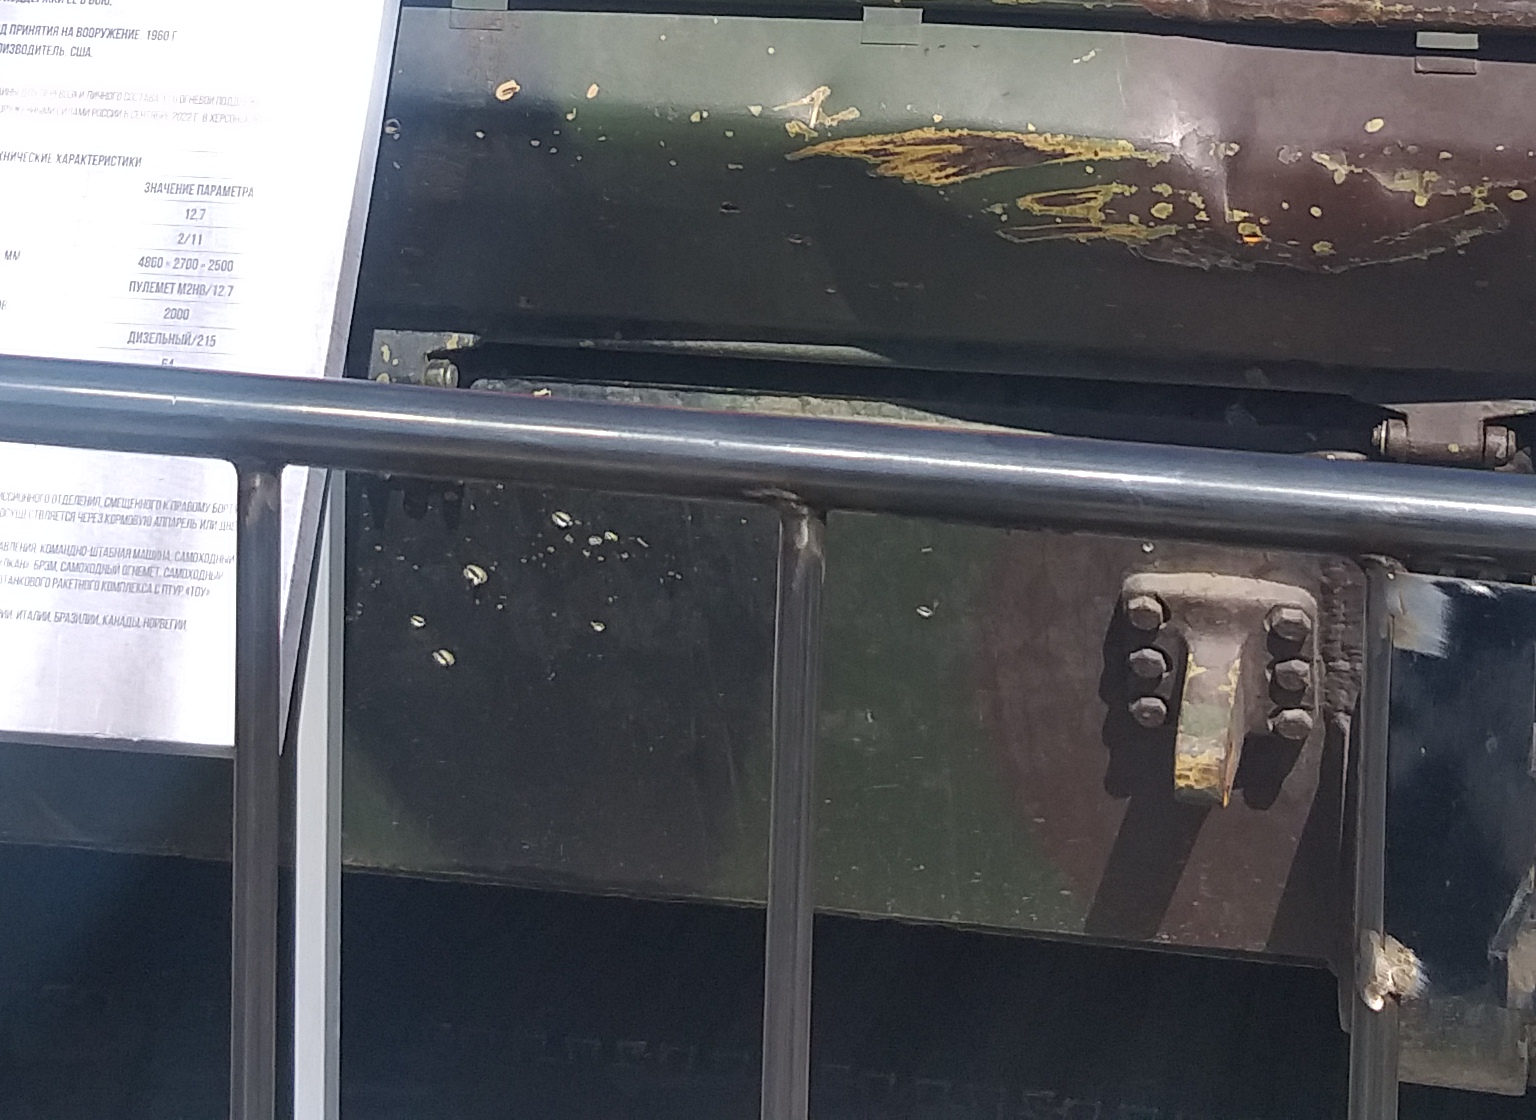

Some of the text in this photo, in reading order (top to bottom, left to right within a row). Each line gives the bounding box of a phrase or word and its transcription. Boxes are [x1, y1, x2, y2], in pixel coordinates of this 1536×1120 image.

[8, 23, 60, 37] ПРИНЯТИЯ
[59, 25, 75, 37] НА
[145, 29, 170, 41] 1960
[54, 152, 143, 168] ХАРАКТЕРИСТИКИ
[142, 181, 256, 198] ЗНАЧЕНИЕ ПАРАМЕТРА
[175, 232, 203, 246] 2/11
[137, 255, 235, 272] 4860 2700 2500
[127, 279, 176, 294] ПУЛЕМЕТ
[162, 307, 191, 321] 2000
[126, 328, 218, 348] ДИЗЕЛЬНЫЙ/215
[103, 496, 162, 511] СМЕЩЕННОГО
[168, 500, 211, 514] ПРАВОМУ
[76, 511, 104, 524] ЧЕРЕЗ
[102, 512, 153, 527] КОРМОВУЮ
[151, 515, 199, 530] АППАРЕЛЬ
[58, 560, 121, 575] САМОХОДНЫЙ
[50, 576, 101, 591] РАКЕТНОГО
[99, 579, 153, 594] КОМПЛЕКСА
